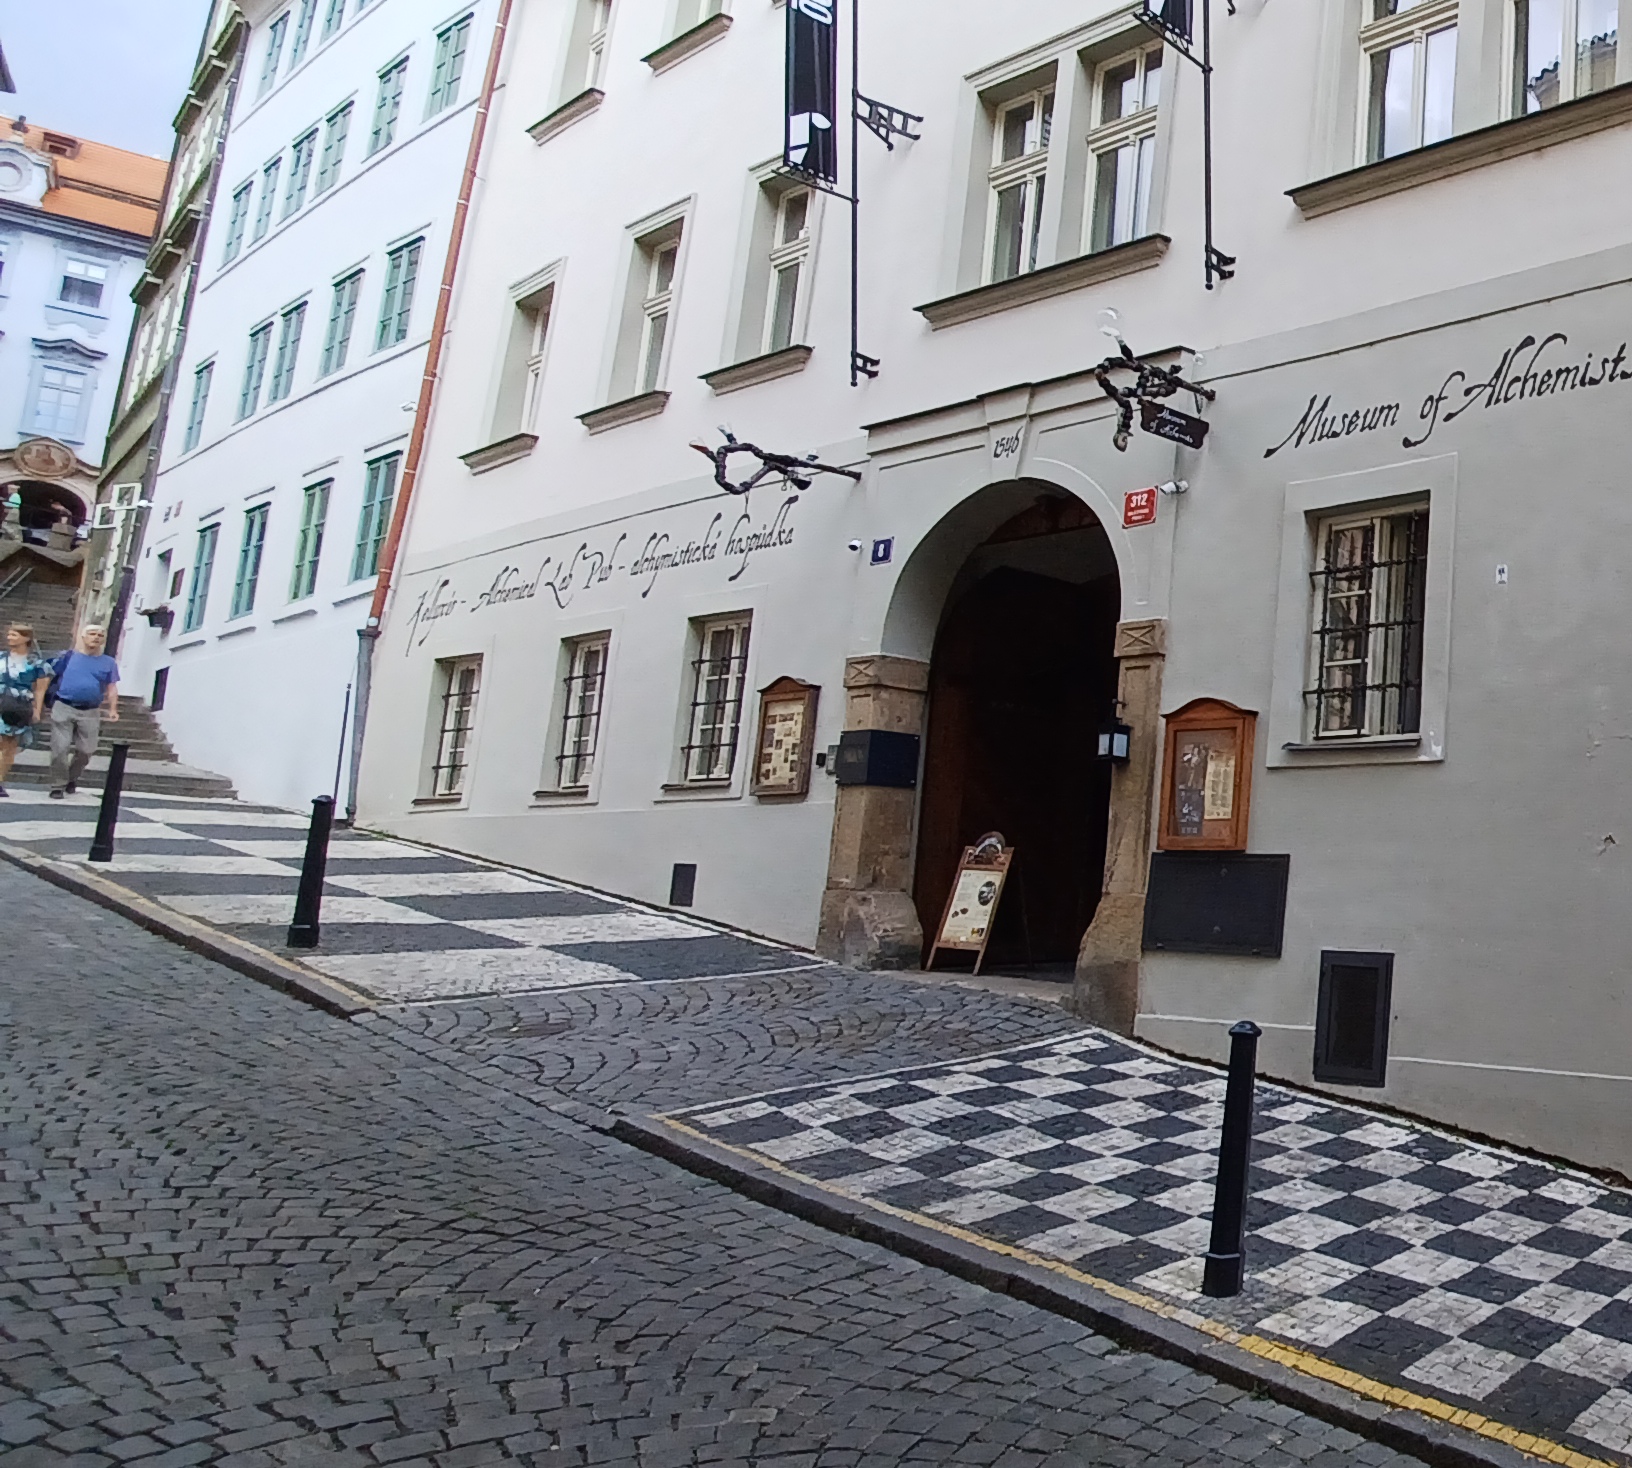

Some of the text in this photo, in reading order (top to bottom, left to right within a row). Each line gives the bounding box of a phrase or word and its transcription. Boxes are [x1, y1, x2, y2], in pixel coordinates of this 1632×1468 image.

[1263, 393, 1400, 459] Museum
[1402, 371, 1466, 449] of
[993, 425, 1024, 458] 1546
[1130, 493, 1149, 507] 312
[582, 532, 627, 590] Pub
